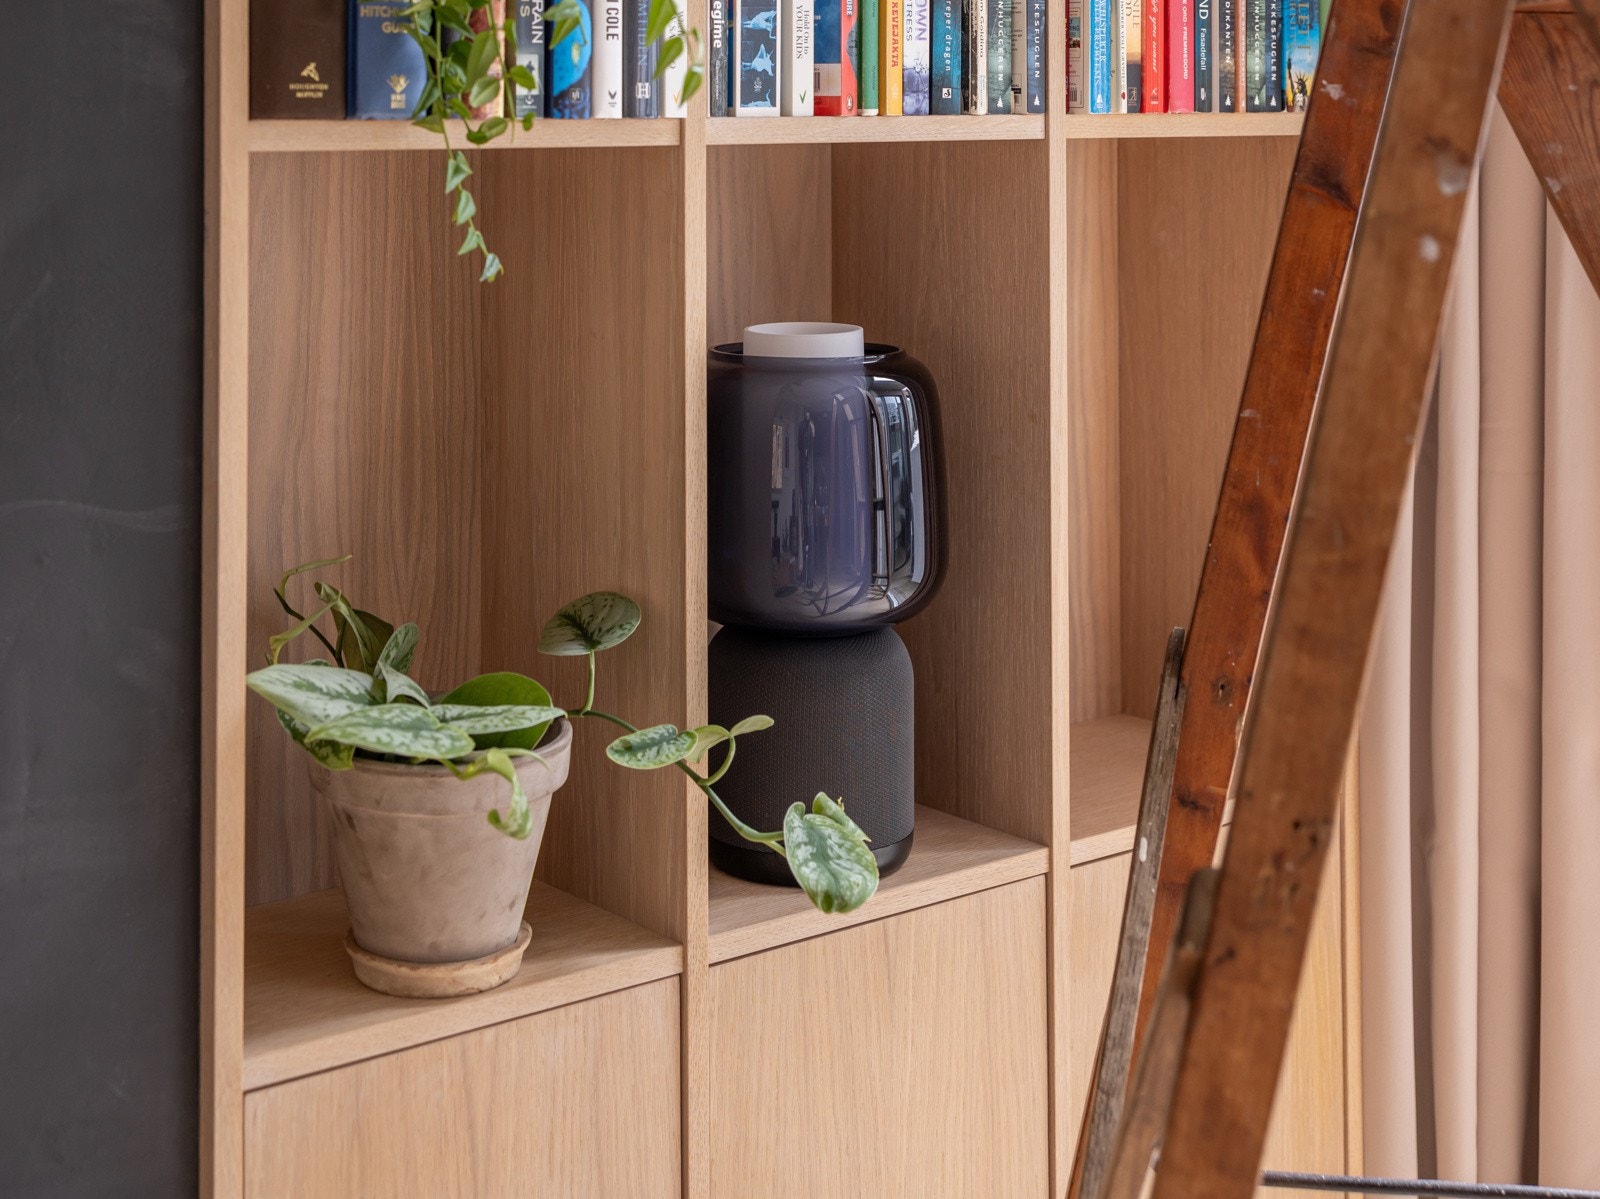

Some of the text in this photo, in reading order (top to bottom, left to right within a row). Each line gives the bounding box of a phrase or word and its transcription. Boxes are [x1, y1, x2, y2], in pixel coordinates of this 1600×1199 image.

[606, 7, 620, 40] COLE
[795, 5, 803, 59] YOUR KIDS
[804, 30, 810, 43] On
[1150, 16, 1158, 37] you
[803, 45, 810, 55] to
[944, 35, 953, 72] dragen
[1150, 40, 1158, 73] want
